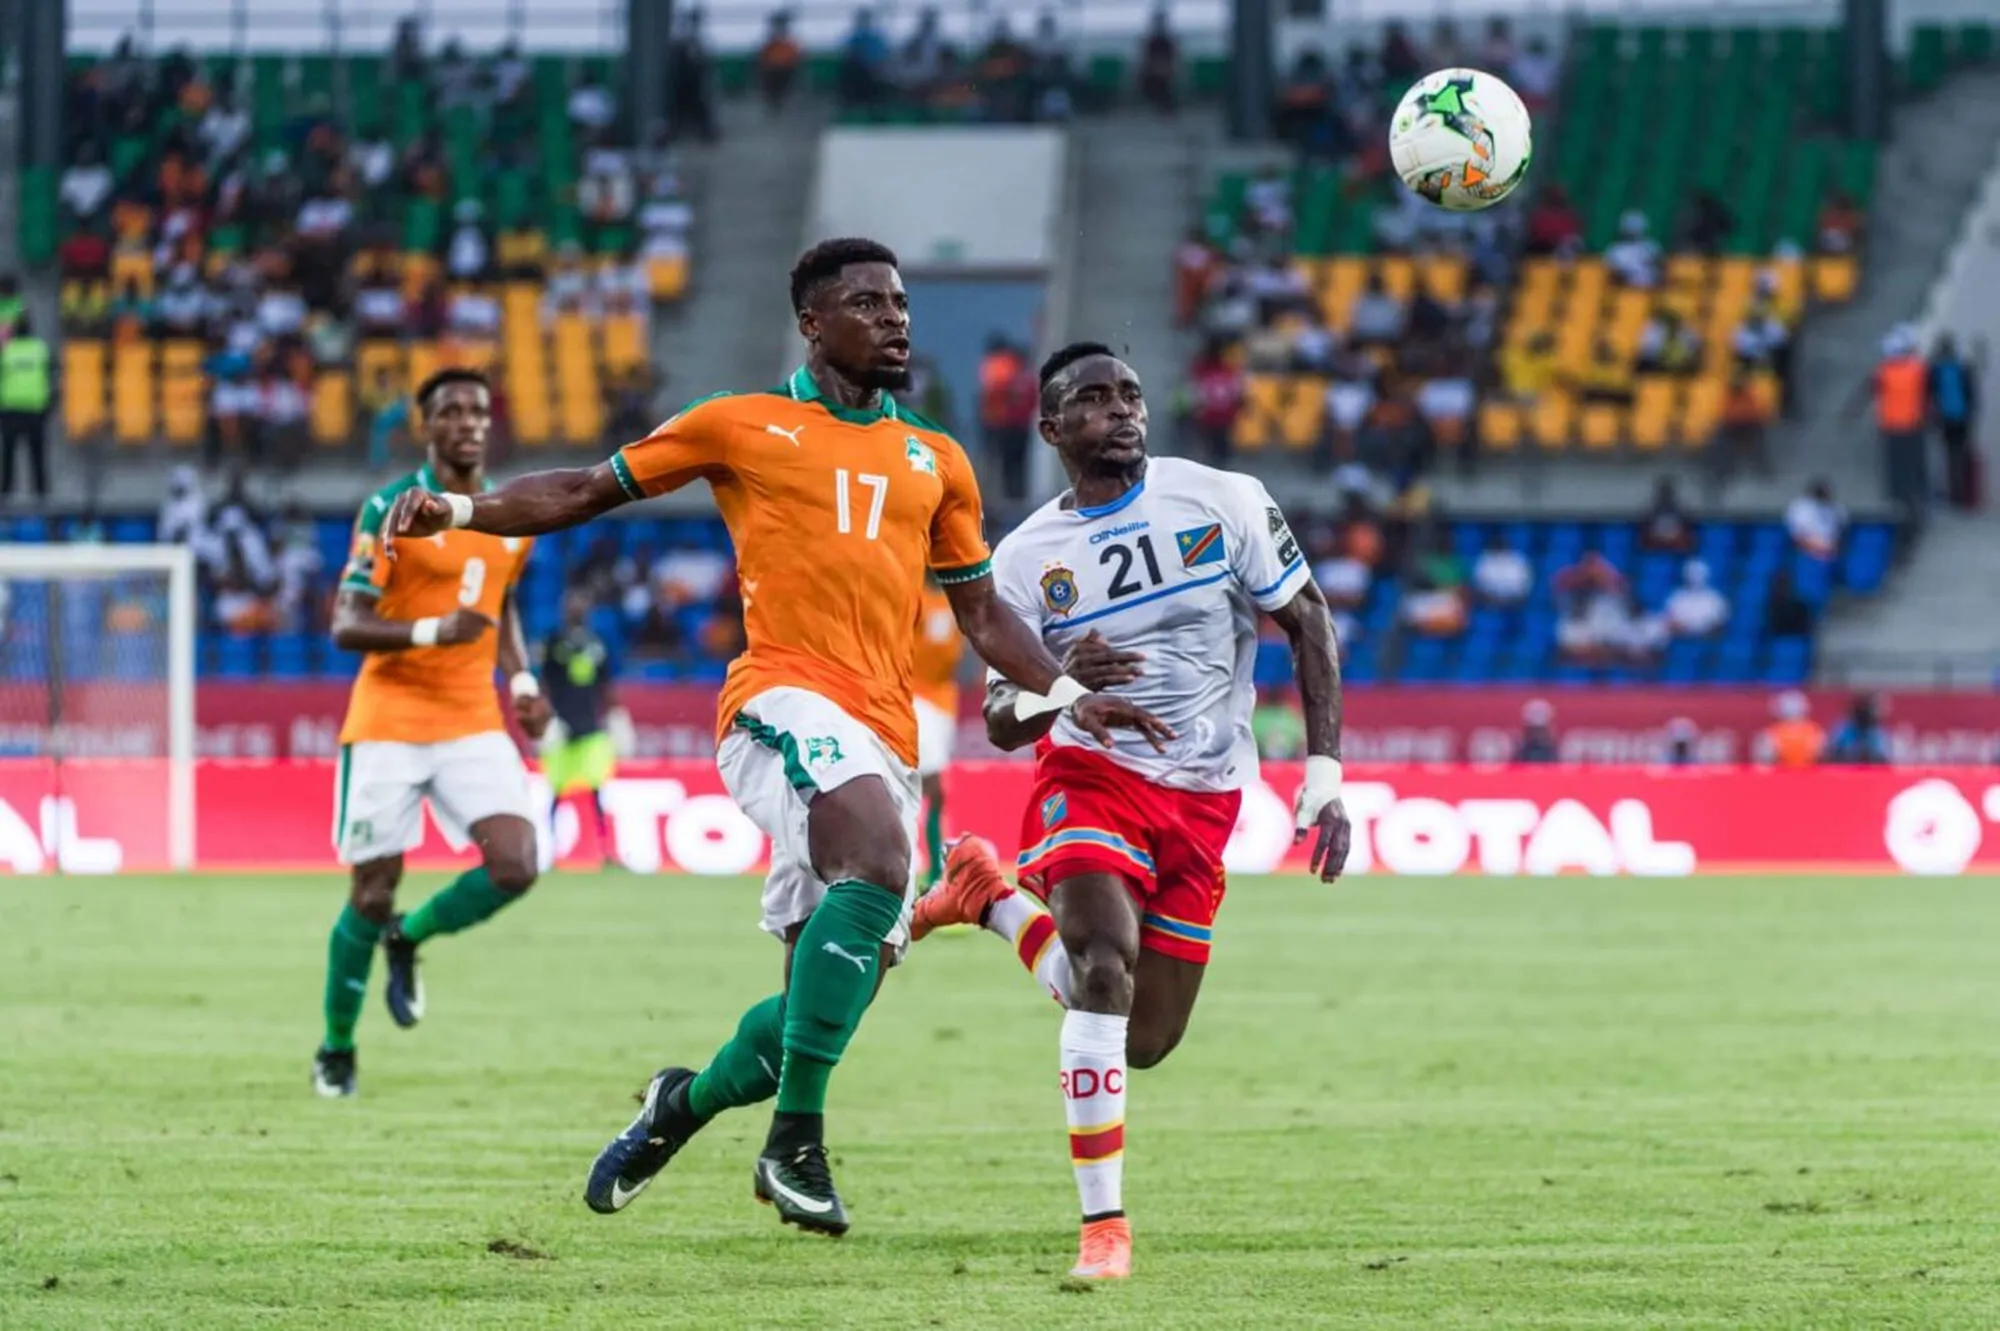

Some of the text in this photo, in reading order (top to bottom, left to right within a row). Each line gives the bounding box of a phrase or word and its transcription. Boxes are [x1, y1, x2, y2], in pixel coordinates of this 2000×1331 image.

[835, 468, 890, 541] 17
[457, 557, 486, 607] 9
[1099, 534, 1164, 600] 21
[1294, 781, 1697, 877] TOTAL
